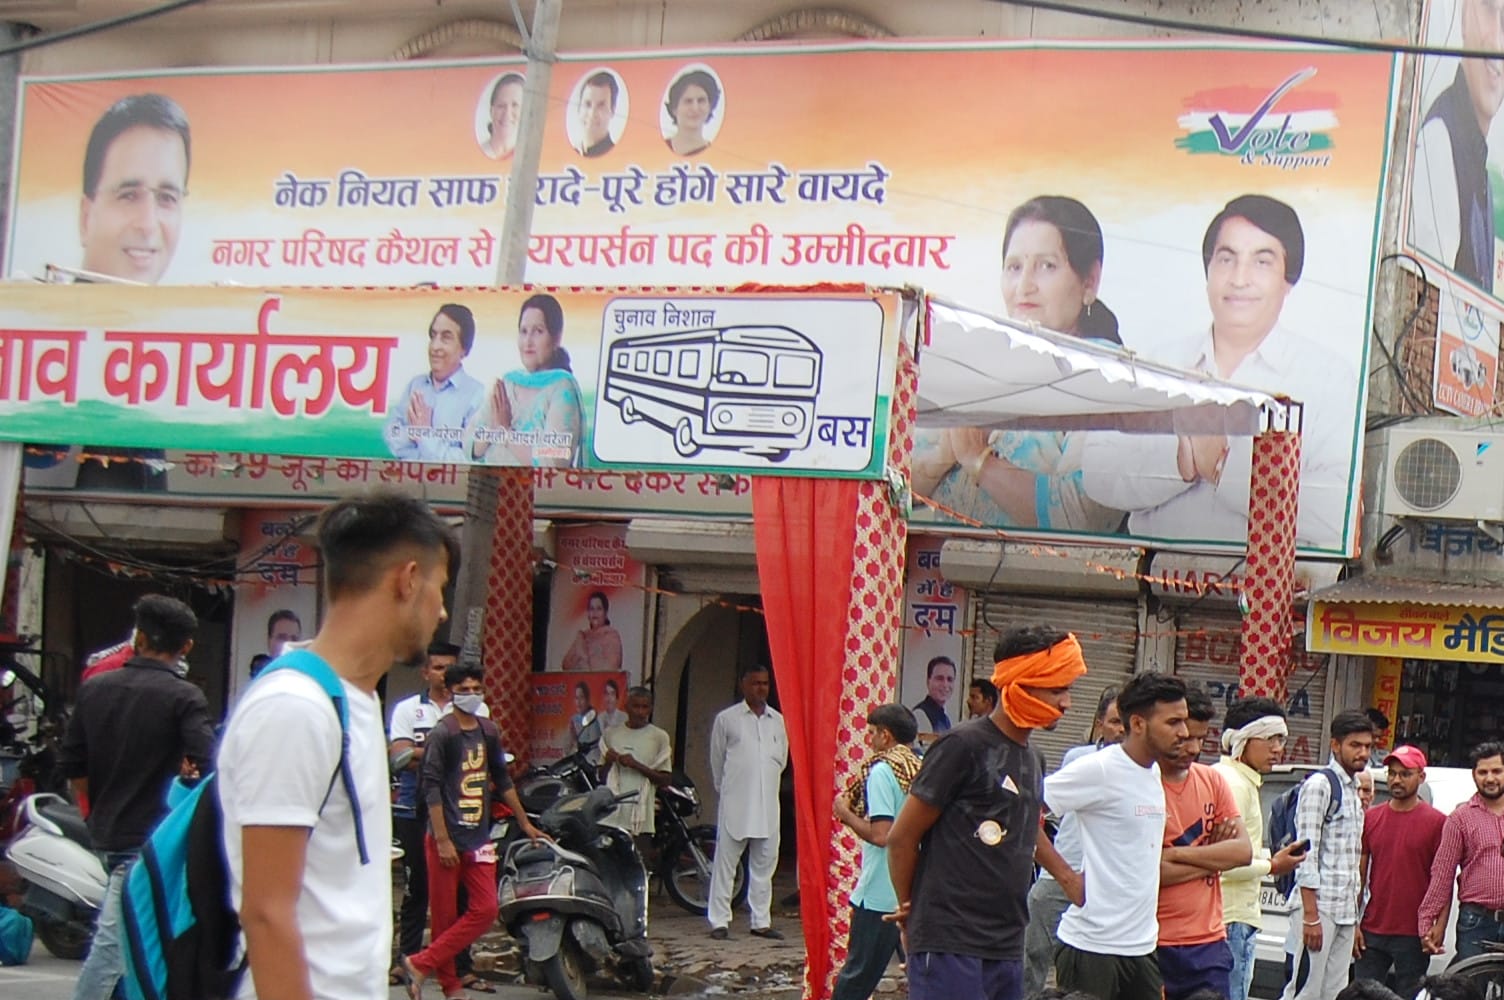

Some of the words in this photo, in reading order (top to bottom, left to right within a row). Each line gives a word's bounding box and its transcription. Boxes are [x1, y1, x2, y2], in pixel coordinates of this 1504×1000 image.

[1208, 67, 1318, 152] Vote
[1241, 150, 1257, 165] &
[1261, 151, 1330, 170] Support
[274, 173, 331, 207] नेक
[337, 170, 421, 207] नियत
[428, 176, 499, 207] साफ
[654, 163, 719, 204] होंगे
[725, 165, 790, 204] सारे
[799, 164, 889, 205] वायदे
[211, 238, 275, 268] नगर
[282, 229, 369, 268] परिषद
[376, 229, 460, 267] कैथल
[467, 229, 496, 265] से
[527, 225, 658, 269] यरपर्सन
[667, 233, 717, 269] पद
[725, 222, 773, 267] की
[781, 222, 957, 269] उम्मीदवार
[613, 308, 657, 334] चुनाव
[663, 302, 716, 328] निशान
[104, 297, 400, 416] कार्यालय
[816, 414, 872, 448] बस
[911, 604, 958, 638] दम
[1320, 606, 1437, 649] विजय
